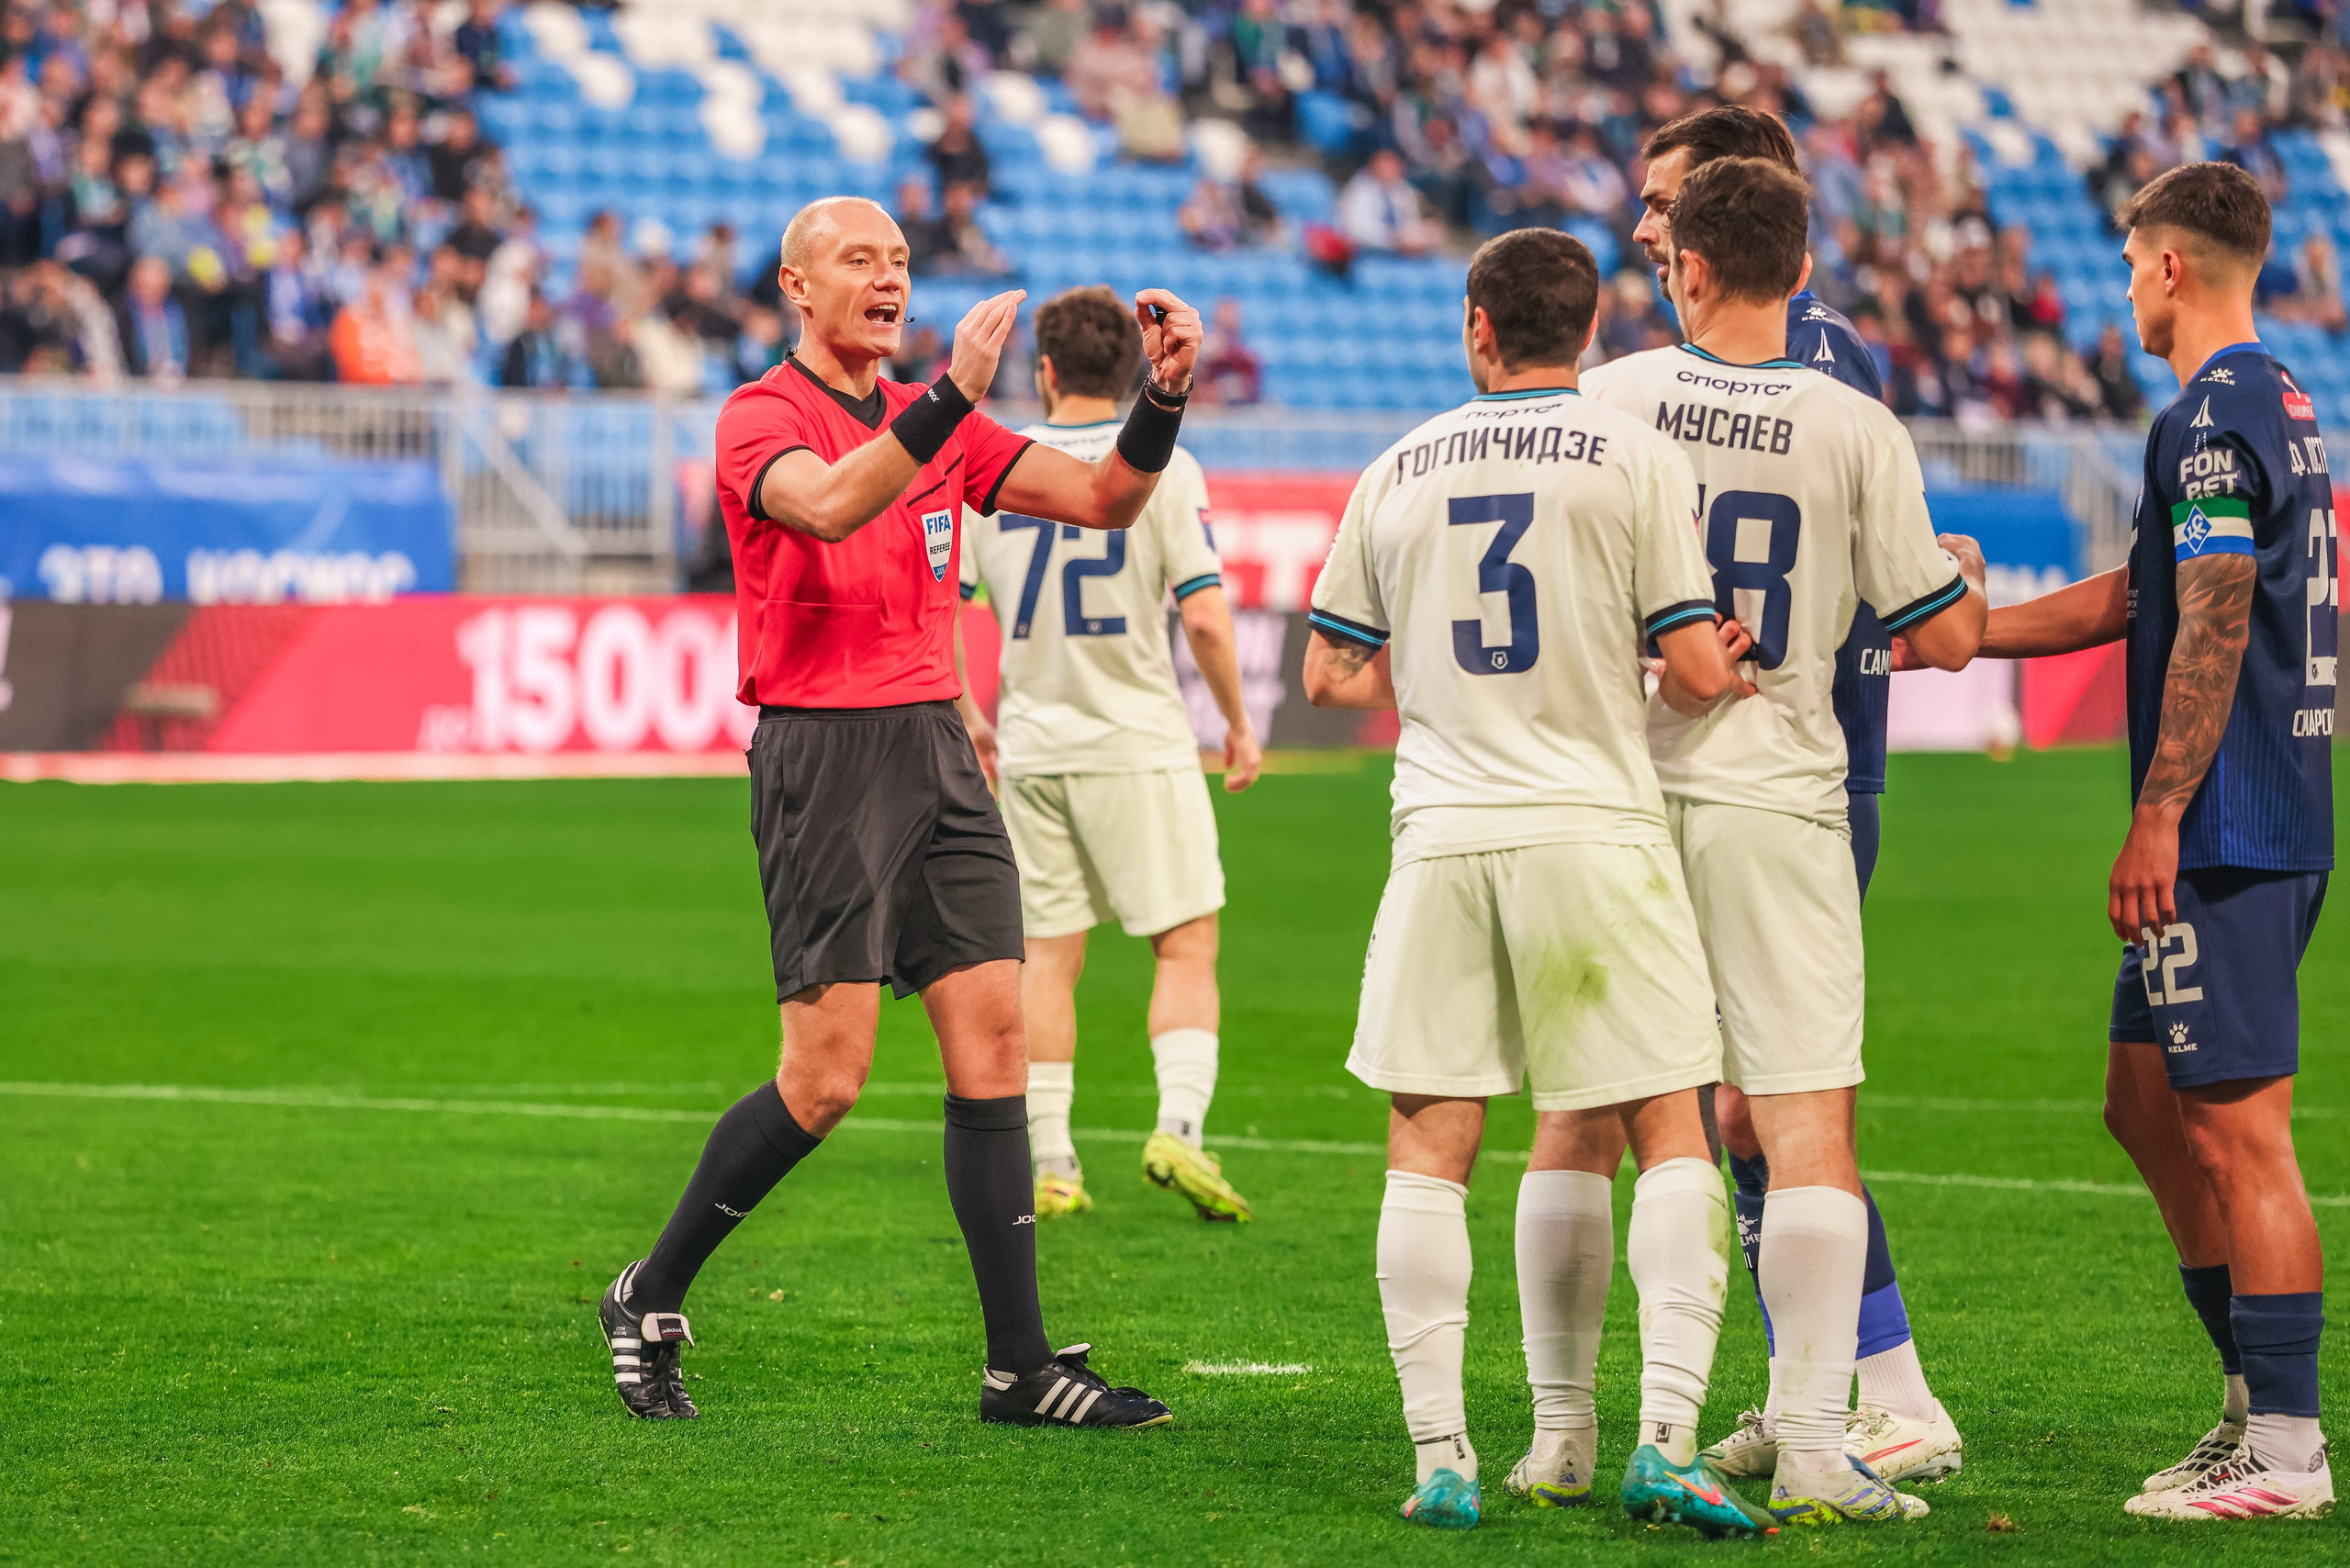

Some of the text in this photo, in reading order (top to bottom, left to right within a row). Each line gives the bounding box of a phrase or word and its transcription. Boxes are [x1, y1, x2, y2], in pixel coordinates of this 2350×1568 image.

[1656, 401, 1793, 455] МУСАЕВ
[1396, 426, 1607, 486] ГОГЛИЧИДЗЕ
[2180, 449, 2233, 483] FON
[2186, 473, 2238, 501] BET
[925, 514, 951, 535] FIFA
[929, 542, 951, 555] REFEREE
[1000, 513, 1127, 640] 72
[1449, 492, 1539, 675] 3
[1647, 484, 1801, 670] 8
[2141, 923, 2203, 1006] 22
[2167, 1043, 2198, 1054] KELME
